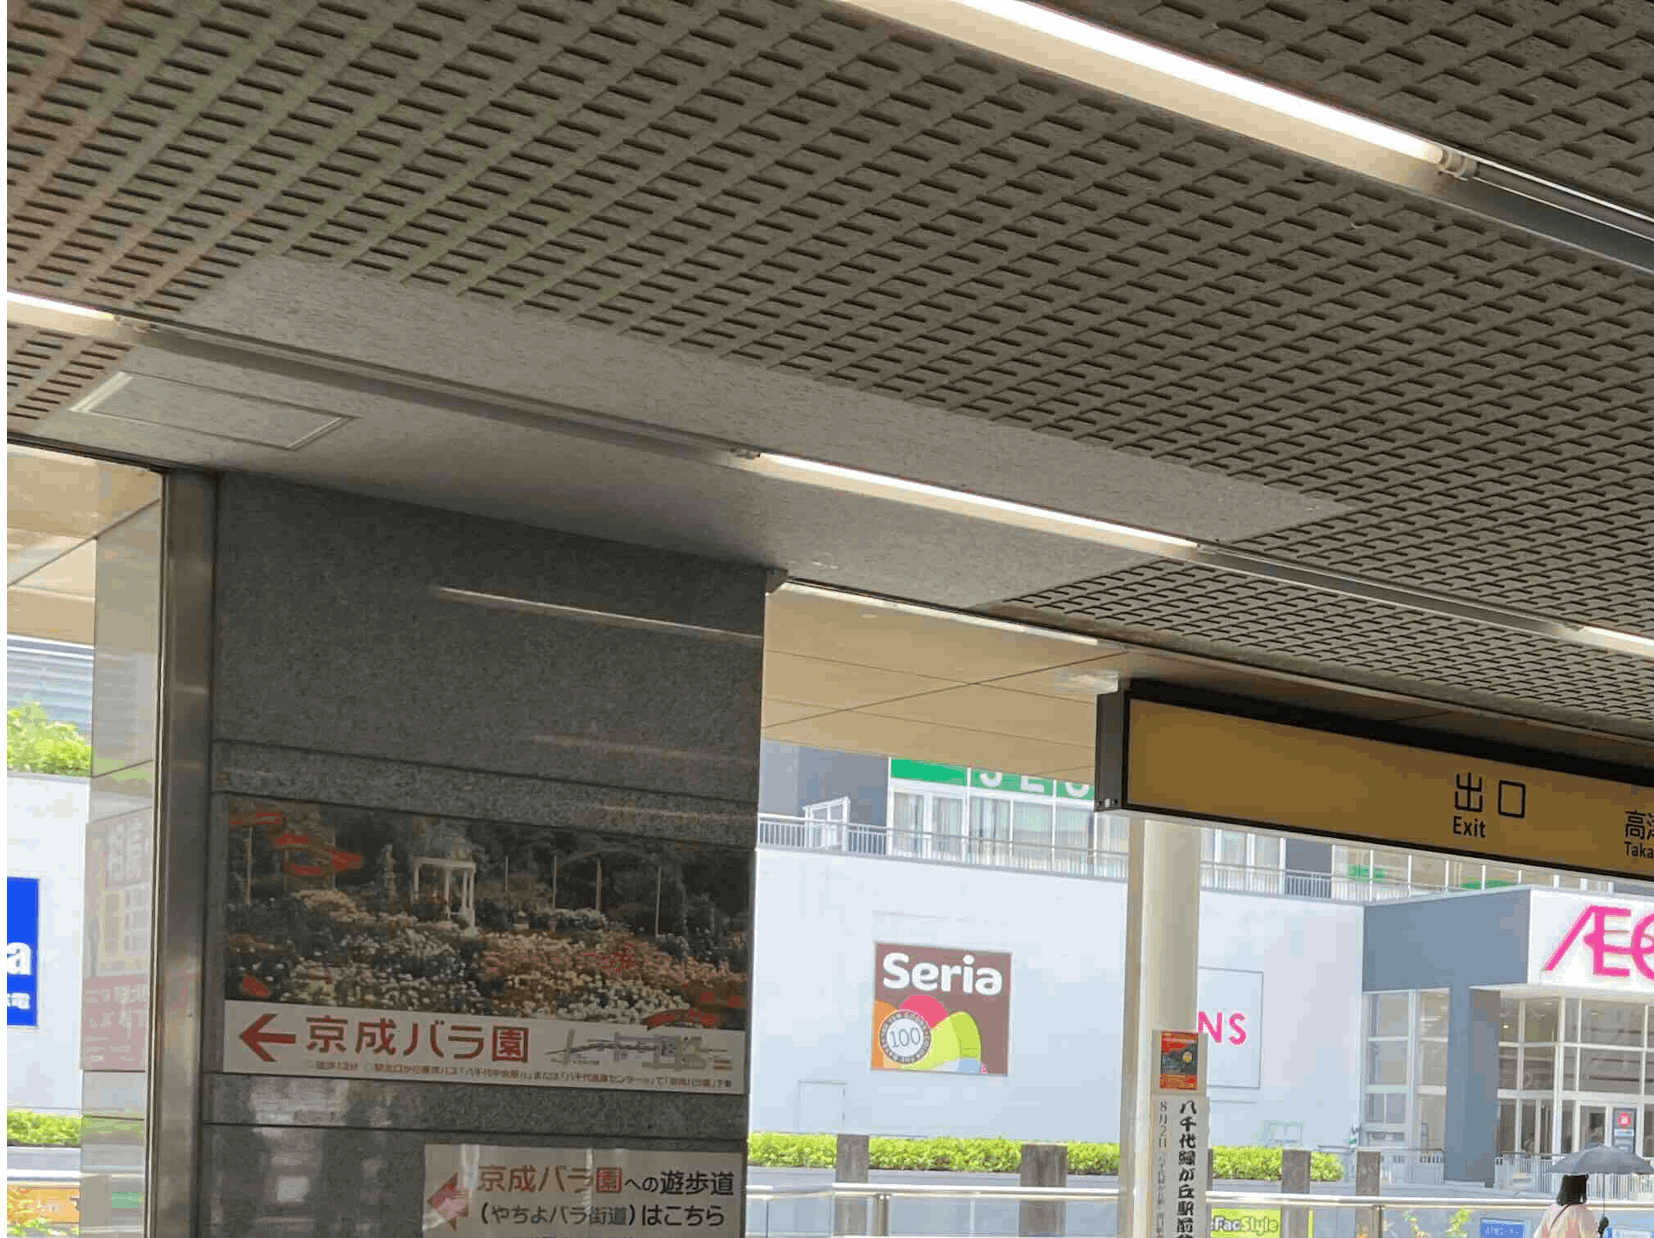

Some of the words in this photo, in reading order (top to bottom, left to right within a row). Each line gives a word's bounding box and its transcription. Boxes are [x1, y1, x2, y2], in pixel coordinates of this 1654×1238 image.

[1453, 771, 1526, 819] 出口
[1452, 815, 1487, 839] Exit
[883, 952, 1003, 996] Seria
[306, 1014, 530, 1063] 京成バラ園
[889, 1026, 921, 1048] 100
[477, 1164, 735, 1196] 京成バラ園への遊歩道
